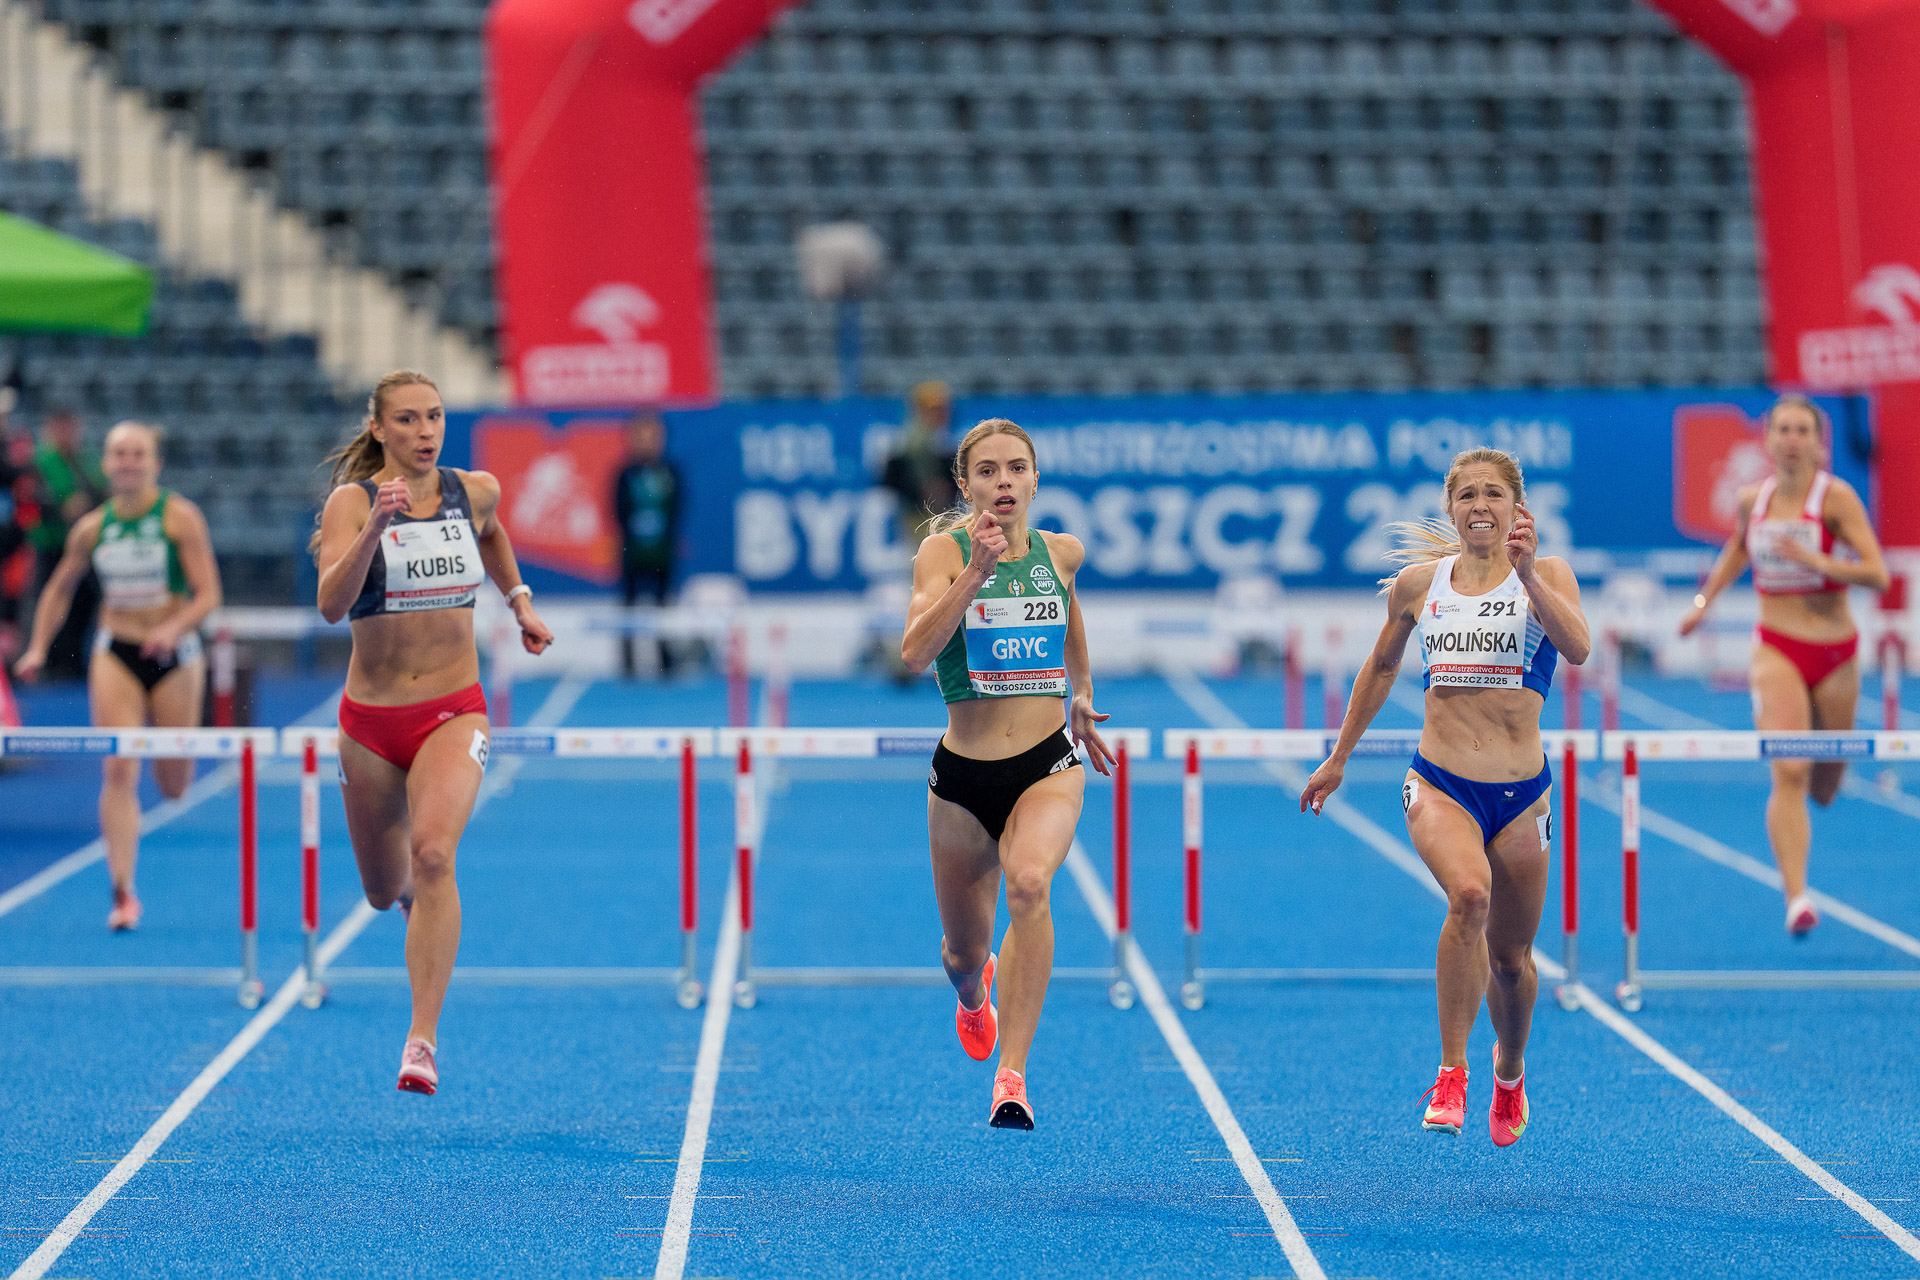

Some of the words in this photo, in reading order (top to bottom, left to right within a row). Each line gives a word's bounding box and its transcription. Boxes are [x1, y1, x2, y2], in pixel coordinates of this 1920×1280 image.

[440, 525, 462, 541] 13
[734, 485, 1325, 580] BYDOSZCZ
[1344, 482, 1572, 576] 205
[407, 556, 466, 579] KUBIS
[1034, 569, 1049, 577] AZS
[1037, 580, 1053, 589] AWF
[399, 598, 452, 608] BYDGOSZCZ
[1477, 600, 1517, 617] 291
[1023, 601, 1058, 621] 228
[991, 636, 1048, 660] GRYC
[1425, 627, 1518, 655] SMOLIŃSKA
[987, 673, 1005, 681] PZLA
[1006, 671, 1046, 681] Mistrzostwa
[1046, 669, 1062, 678] Polski
[1431, 665, 1448, 673] PZLA
[1447, 664, 1494, 674] Mistrzostwa
[1494, 666, 1517, 675] Polski
[983, 682, 1037, 692] BYDGOSZCZ
[1038, 681, 1057, 690] 2025
[1484, 676, 1508, 685] 2025
